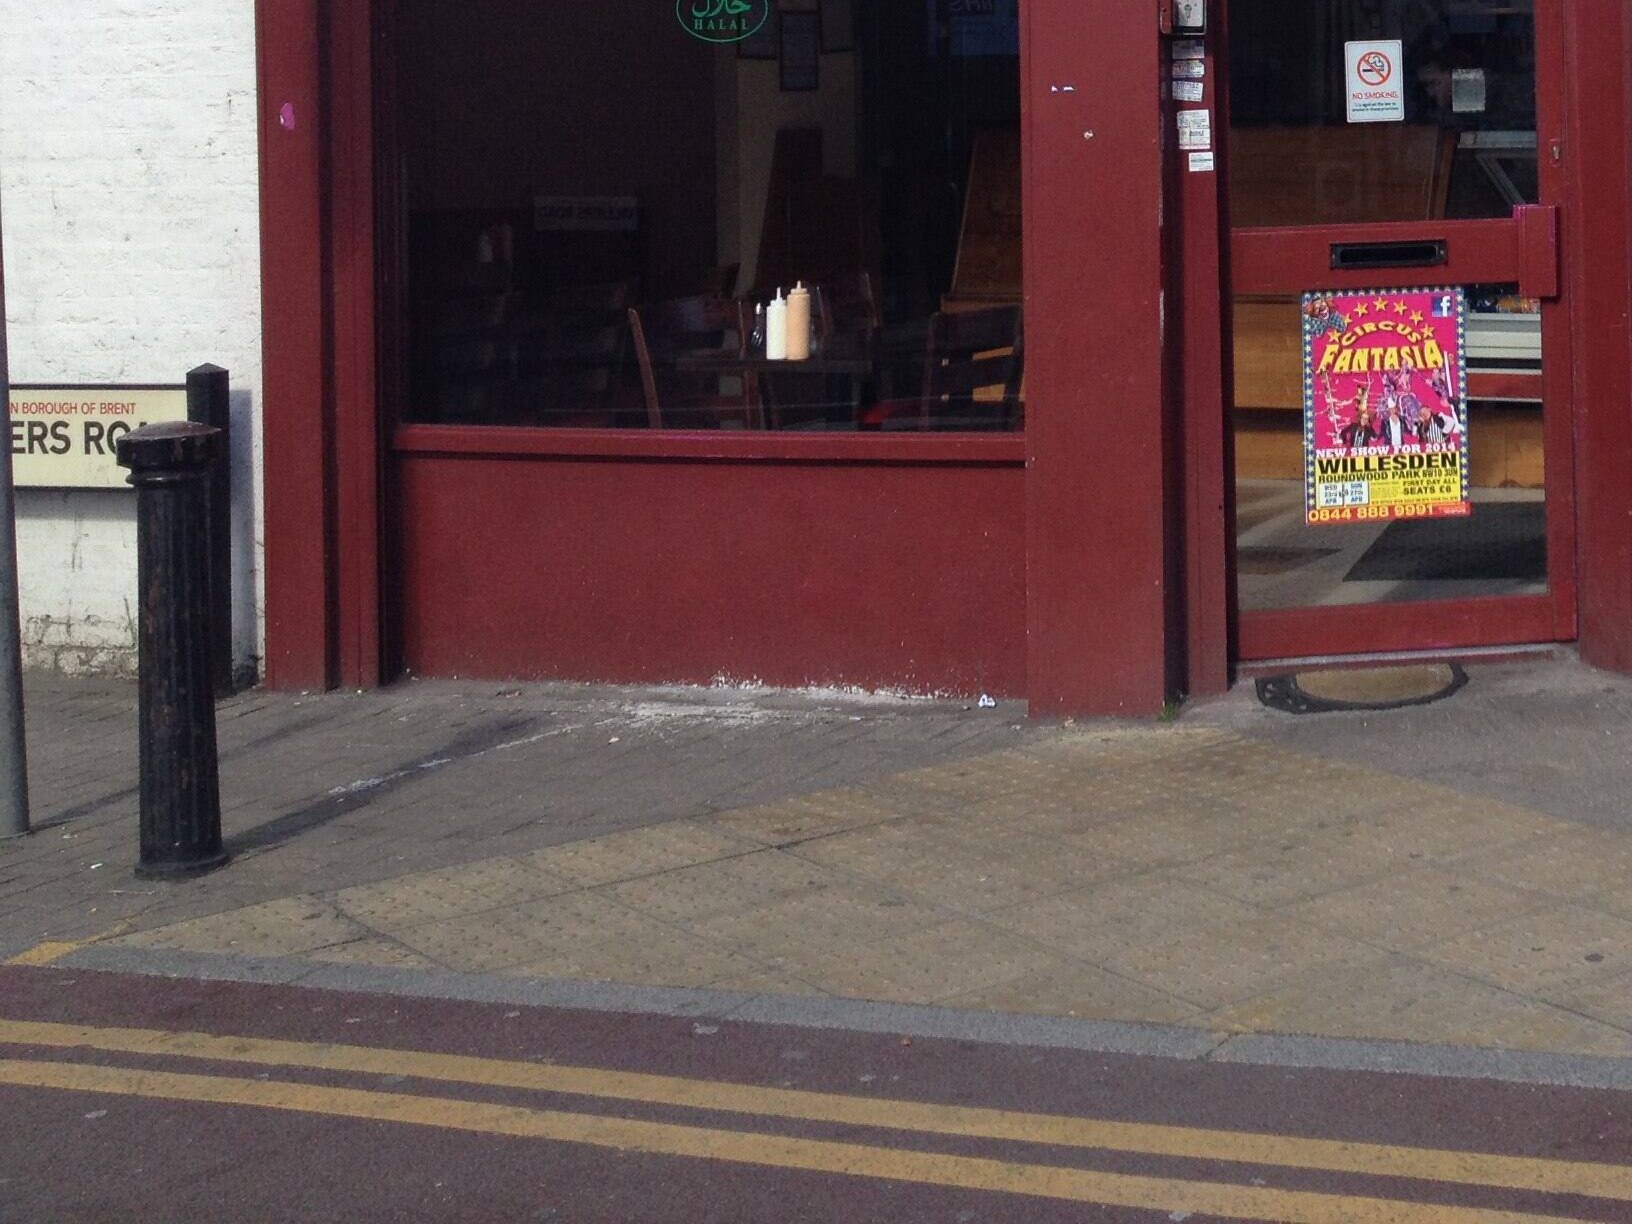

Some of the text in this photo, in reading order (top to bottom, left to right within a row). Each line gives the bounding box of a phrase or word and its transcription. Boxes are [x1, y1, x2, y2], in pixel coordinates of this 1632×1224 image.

[693, 18, 750, 31] HALAL
[1341, 320, 1422, 346] CIRCUS
[1315, 339, 1444, 375] FANTASIA
[22, 402, 77, 415] BOROUGH
[82, 402, 96, 415] OF
[99, 402, 136, 415] BRENT
[1316, 442, 1456, 459] NEW SHOW FOR 2014
[1317, 452, 1457, 475] WILLESDEN
[1318, 471, 1389, 484] ROUNDWOOD
[1392, 469, 1420, 480] PARK
[1403, 486, 1436, 496] SEATS
[1308, 508, 1352, 522] 0844
[1356, 506, 1389, 519] 888
[1394, 504, 1433, 516] 9991
